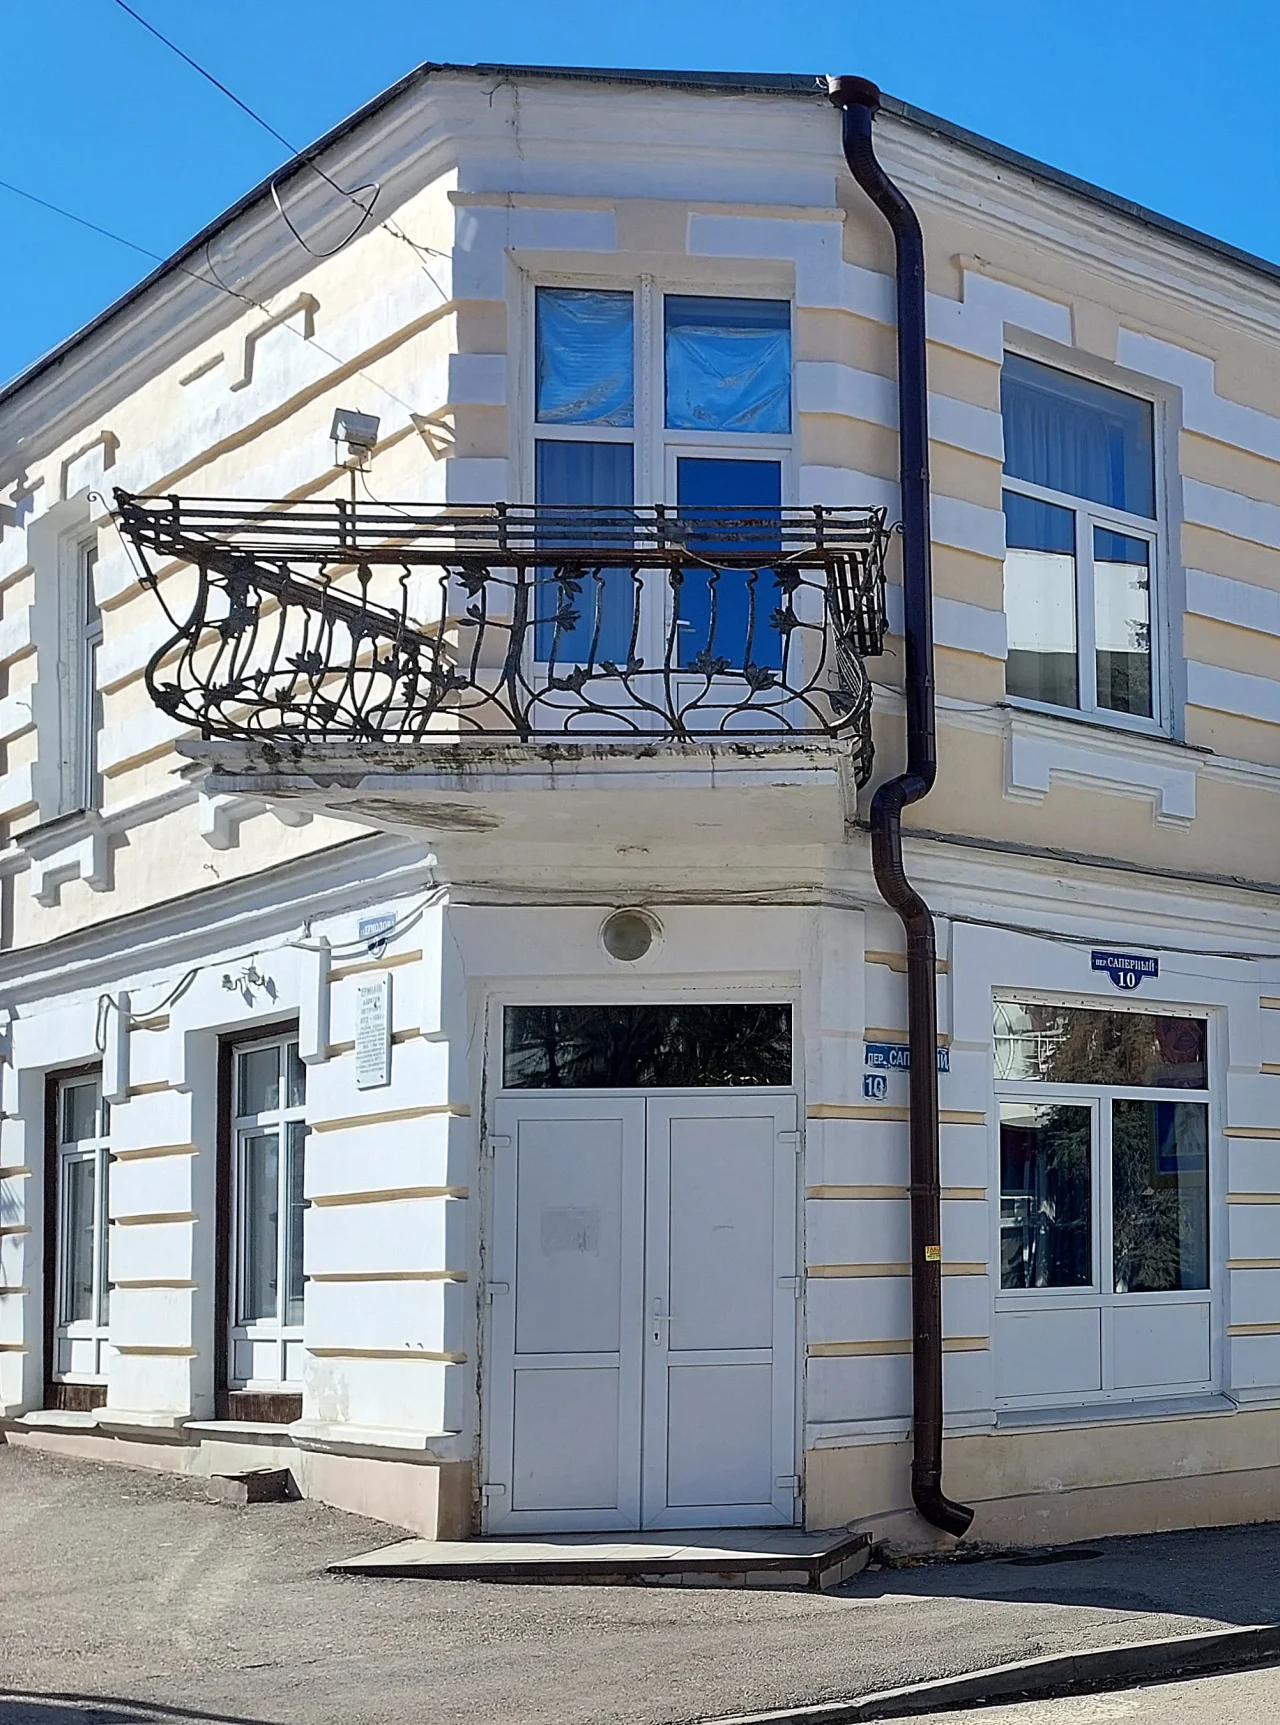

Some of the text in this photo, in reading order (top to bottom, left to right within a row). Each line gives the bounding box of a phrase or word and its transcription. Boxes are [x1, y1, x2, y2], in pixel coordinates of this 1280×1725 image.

[1107, 957, 1155, 972] САПЕРНЫЙ
[1118, 971, 1136, 988] 10
[865, 1076, 885, 1097] 10
